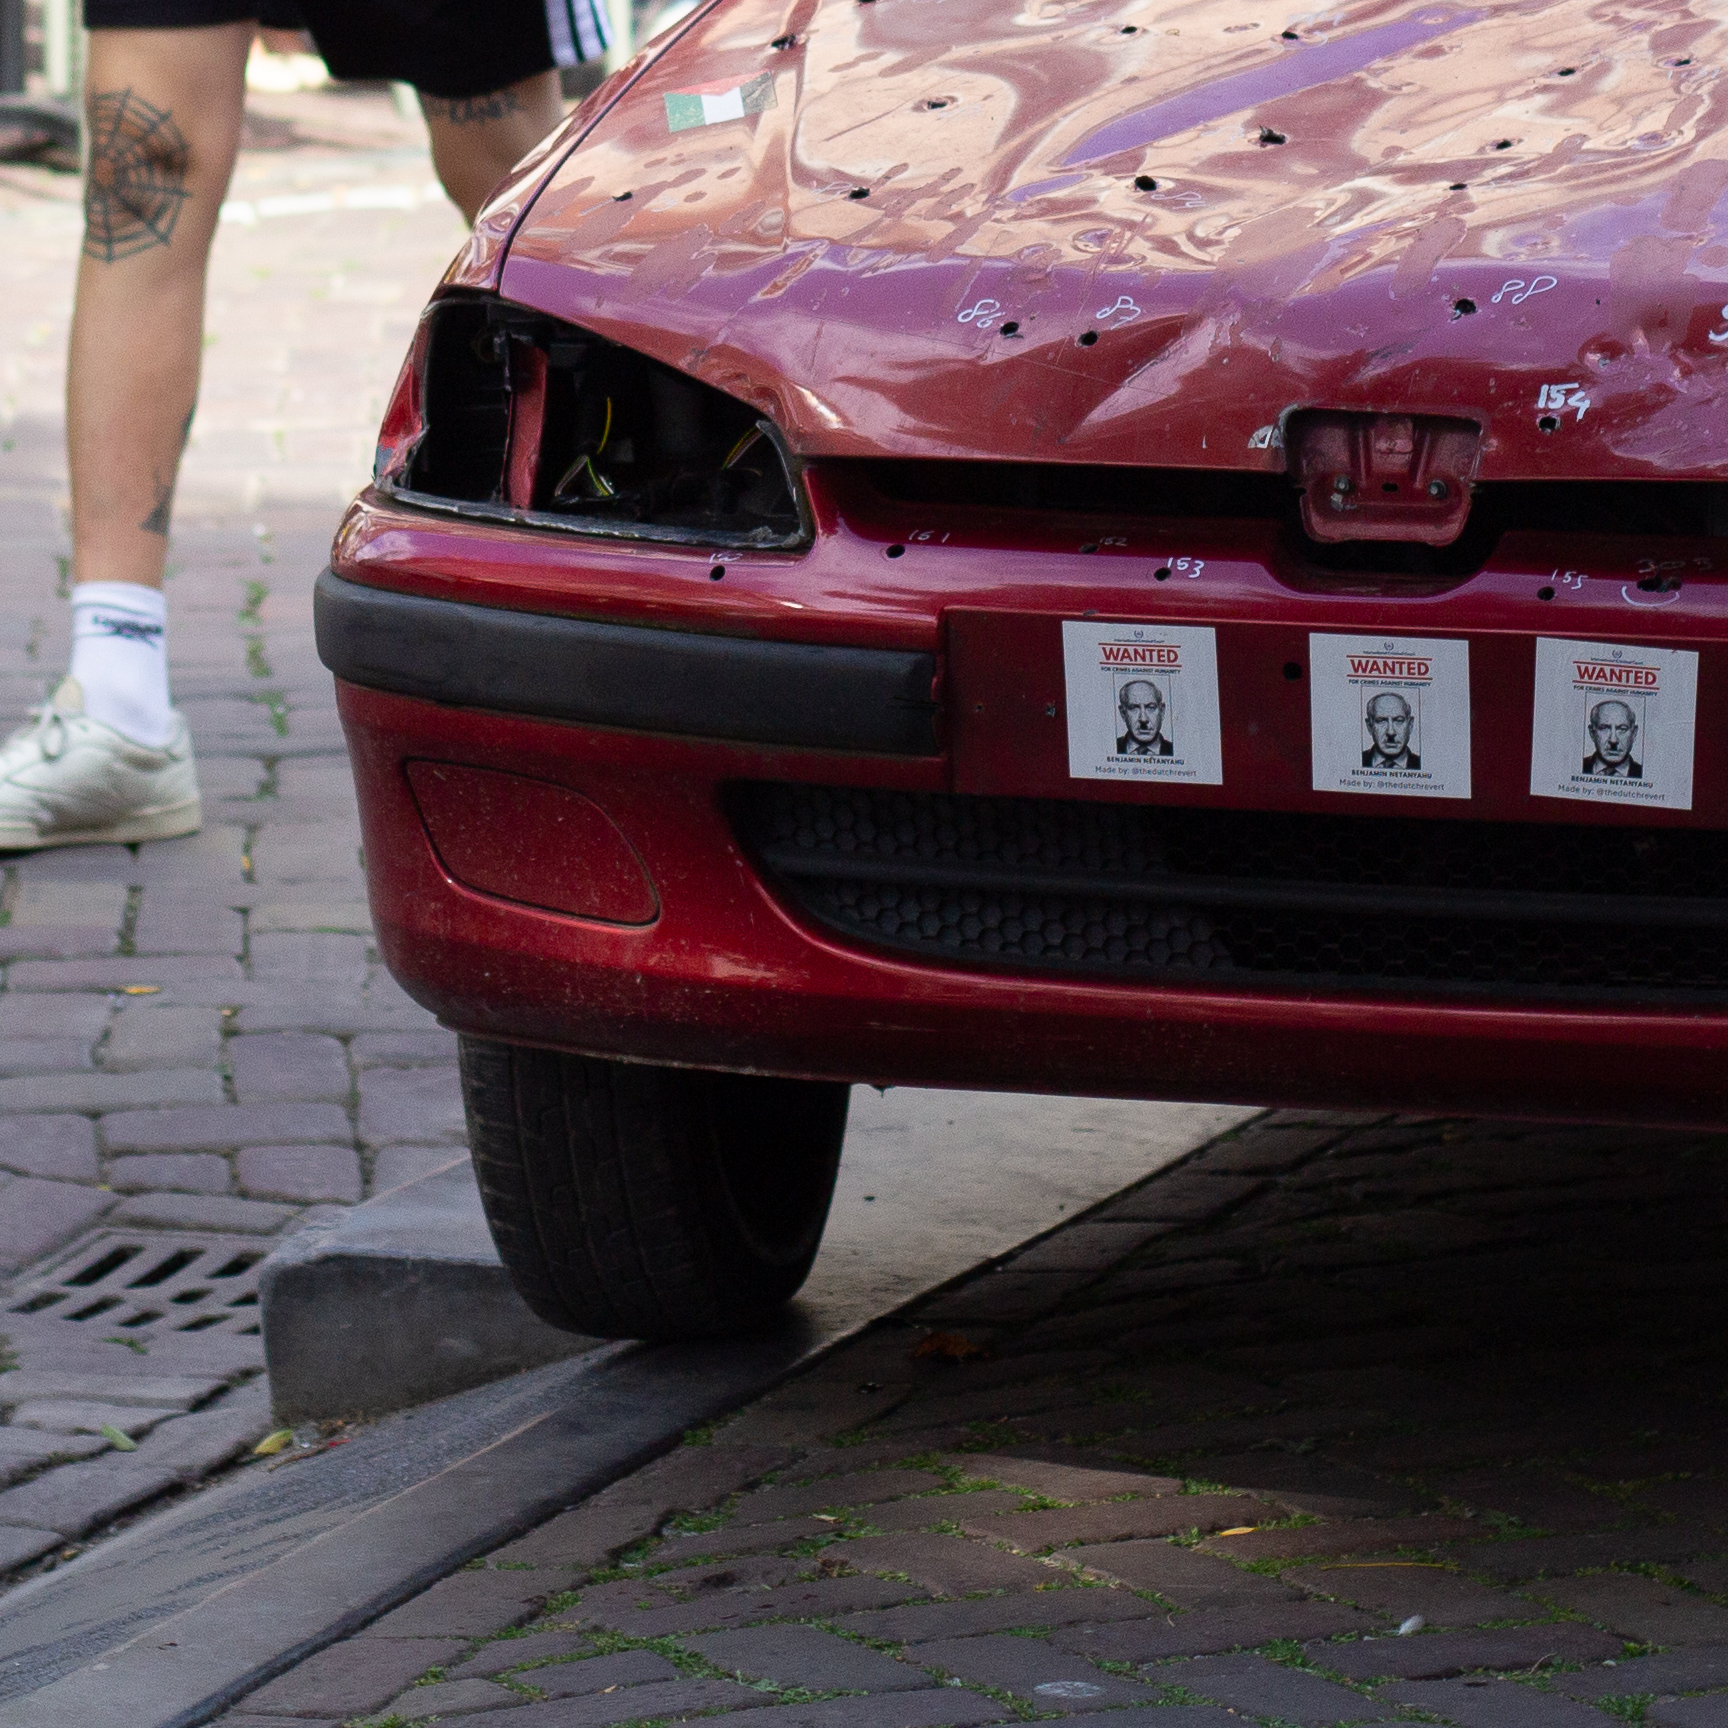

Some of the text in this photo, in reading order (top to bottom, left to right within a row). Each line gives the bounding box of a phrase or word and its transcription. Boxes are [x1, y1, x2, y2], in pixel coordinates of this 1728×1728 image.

[1491, 275, 1558, 305] 88
[1537, 382, 1591, 422] 154
[1167, 557, 1205, 578] 153
[1551, 568, 1589, 590] 155
[1102, 647, 1179, 663] WANTED
[1350, 659, 1429, 676] WANTED
[1576, 665, 1657, 685] WANTED
[1143, 757, 1184, 765] NETANYAHU
[1095, 766, 1197, 777] Made by: @thedutchrevert
[1351, 769, 1432, 779] BENJAMIN NETANYAHU
[1339, 779, 1445, 791] Made by: @thedutchrevert
[1571, 775, 1653, 788] BENJAMIN NETANYAHU
[1558, 785, 1665, 801] Made by: @thedutchrevert
